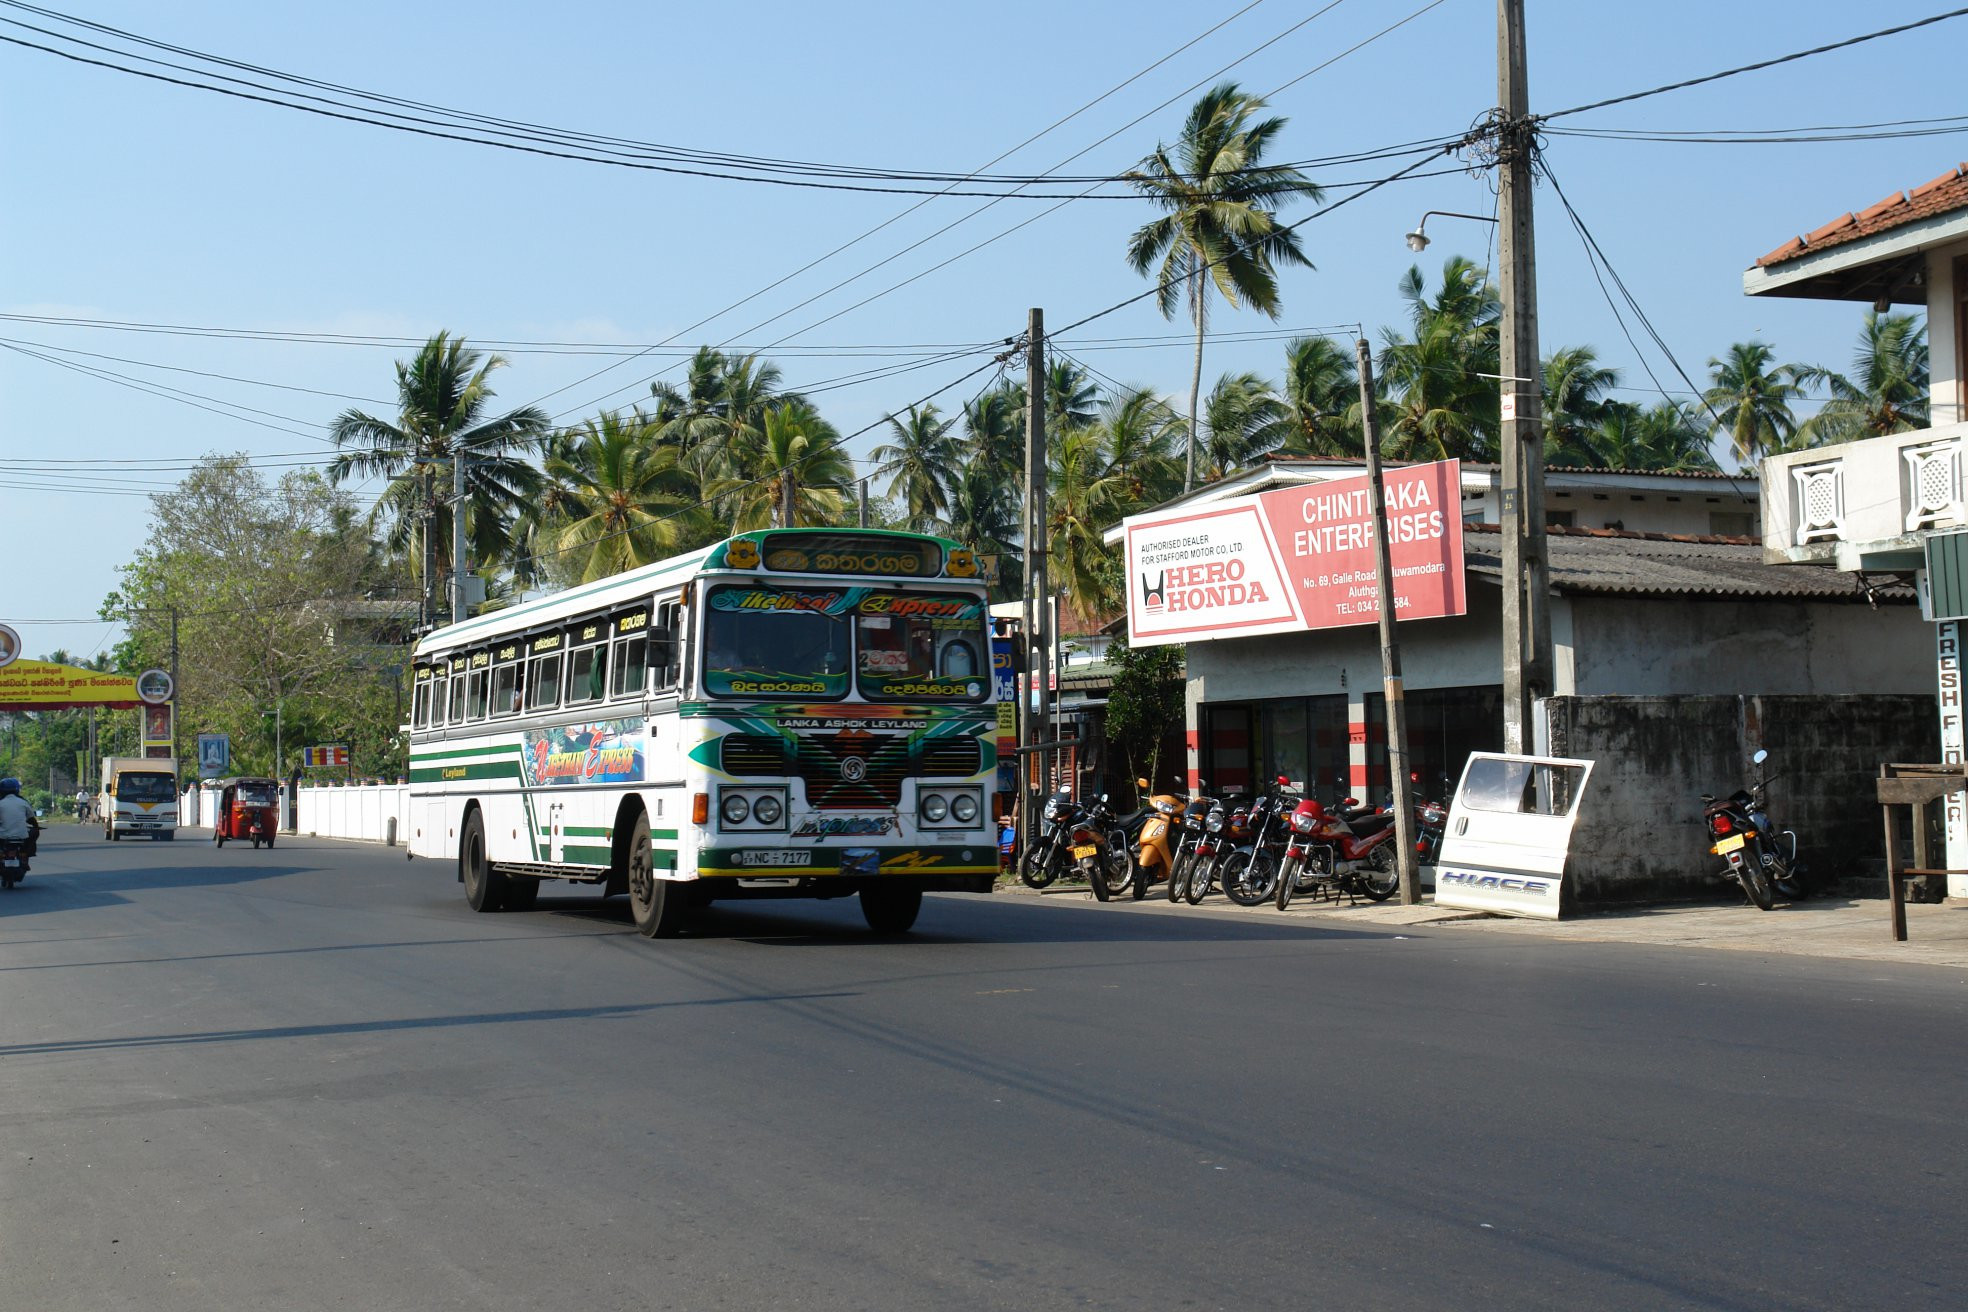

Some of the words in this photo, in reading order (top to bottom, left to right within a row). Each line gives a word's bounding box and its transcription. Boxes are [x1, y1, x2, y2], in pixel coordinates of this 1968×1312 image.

[1141, 539, 1181, 553] AUTHORISED
[1182, 534, 1209, 547] DEALER
[1142, 556, 1155, 565] FOR
[1156, 550, 1189, 563] STAFFORD
[1190, 546, 1214, 558] MOTOR
[1166, 558, 1245, 589] HERO
[1303, 577, 1317, 588] No.
[1332, 572, 1353, 585] Galle
[1167, 581, 1269, 612] HONDA
[1336, 603, 1355, 615] TEL:
[1357, 601, 1373, 613] 034
[1938, 621, 1958, 707] FRESH
[776, 719, 819, 728] LANKA
[824, 719, 866, 729] ASHOK
[868, 720, 928, 730] LEYLAND
[754, 852, 769, 864] NC
[782, 852, 810, 864] 7177
[1441, 871, 1550, 894] HIACE
